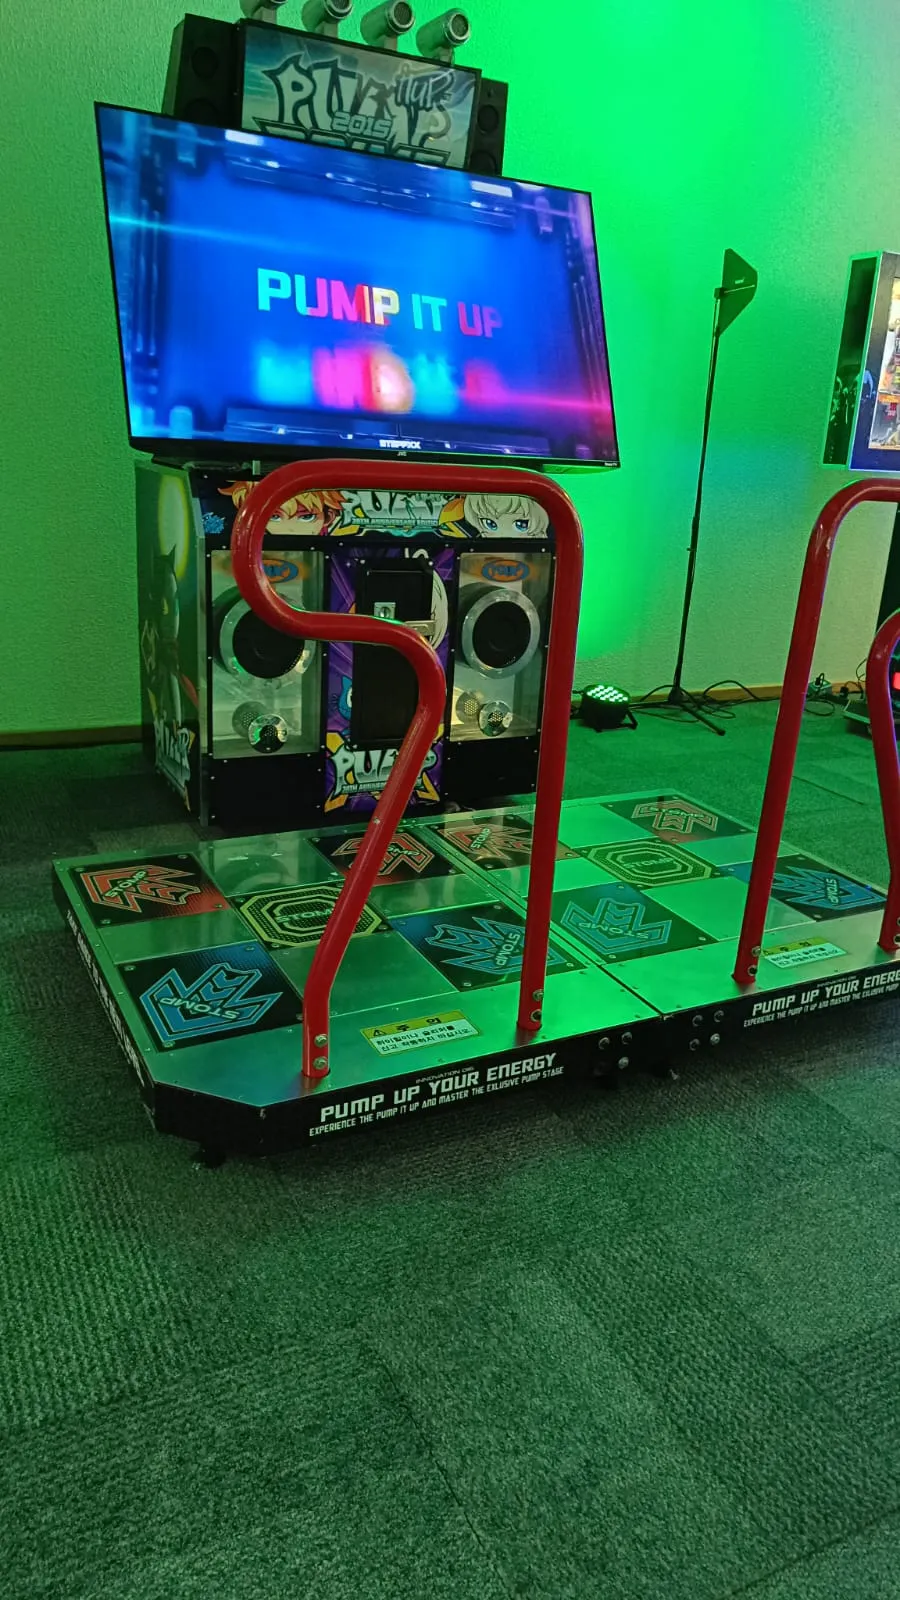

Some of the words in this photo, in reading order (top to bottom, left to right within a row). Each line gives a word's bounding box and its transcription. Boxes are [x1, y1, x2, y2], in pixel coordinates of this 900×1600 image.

[331, 111, 393, 139] 2015
[257, 267, 400, 326] PUMP
[411, 293, 447, 332] IT
[457, 301, 503, 338] UP
[470, 827, 491, 850] STOMP
[104, 870, 147, 898] STOMP
[275, 908, 333, 923] STOM
[578, 922, 649, 939] STOMP
[496, 932, 520, 966] STOMP
[160, 997, 240, 1019] STOMP
[752, 994, 796, 1017] PUMP
[800, 989, 819, 1005] UP
[825, 979, 860, 999] YOUR
[309, 1118, 357, 1137] EXPERIENCE
[360, 1113, 374, 1125] THE
[376, 1107, 399, 1120] PUMP
[400, 1104, 407, 1114] IT
[409, 1101, 420, 1112] UP
[421, 1097, 437, 1109] AND
[439, 1089, 469, 1105] MASTER
[471, 1085, 485, 1096] THE
[486, 1076, 520, 1093] EXLUSIVE
[521, 1071, 541, 1085] PUMP
[542, 1065, 564, 1079] STAGE
[320, 1094, 385, 1123] PUMP
[394, 1085, 420, 1105] UP
[428, 1071, 480, 1096] YOUR
[486, 1052, 557, 1082] ENERGY
